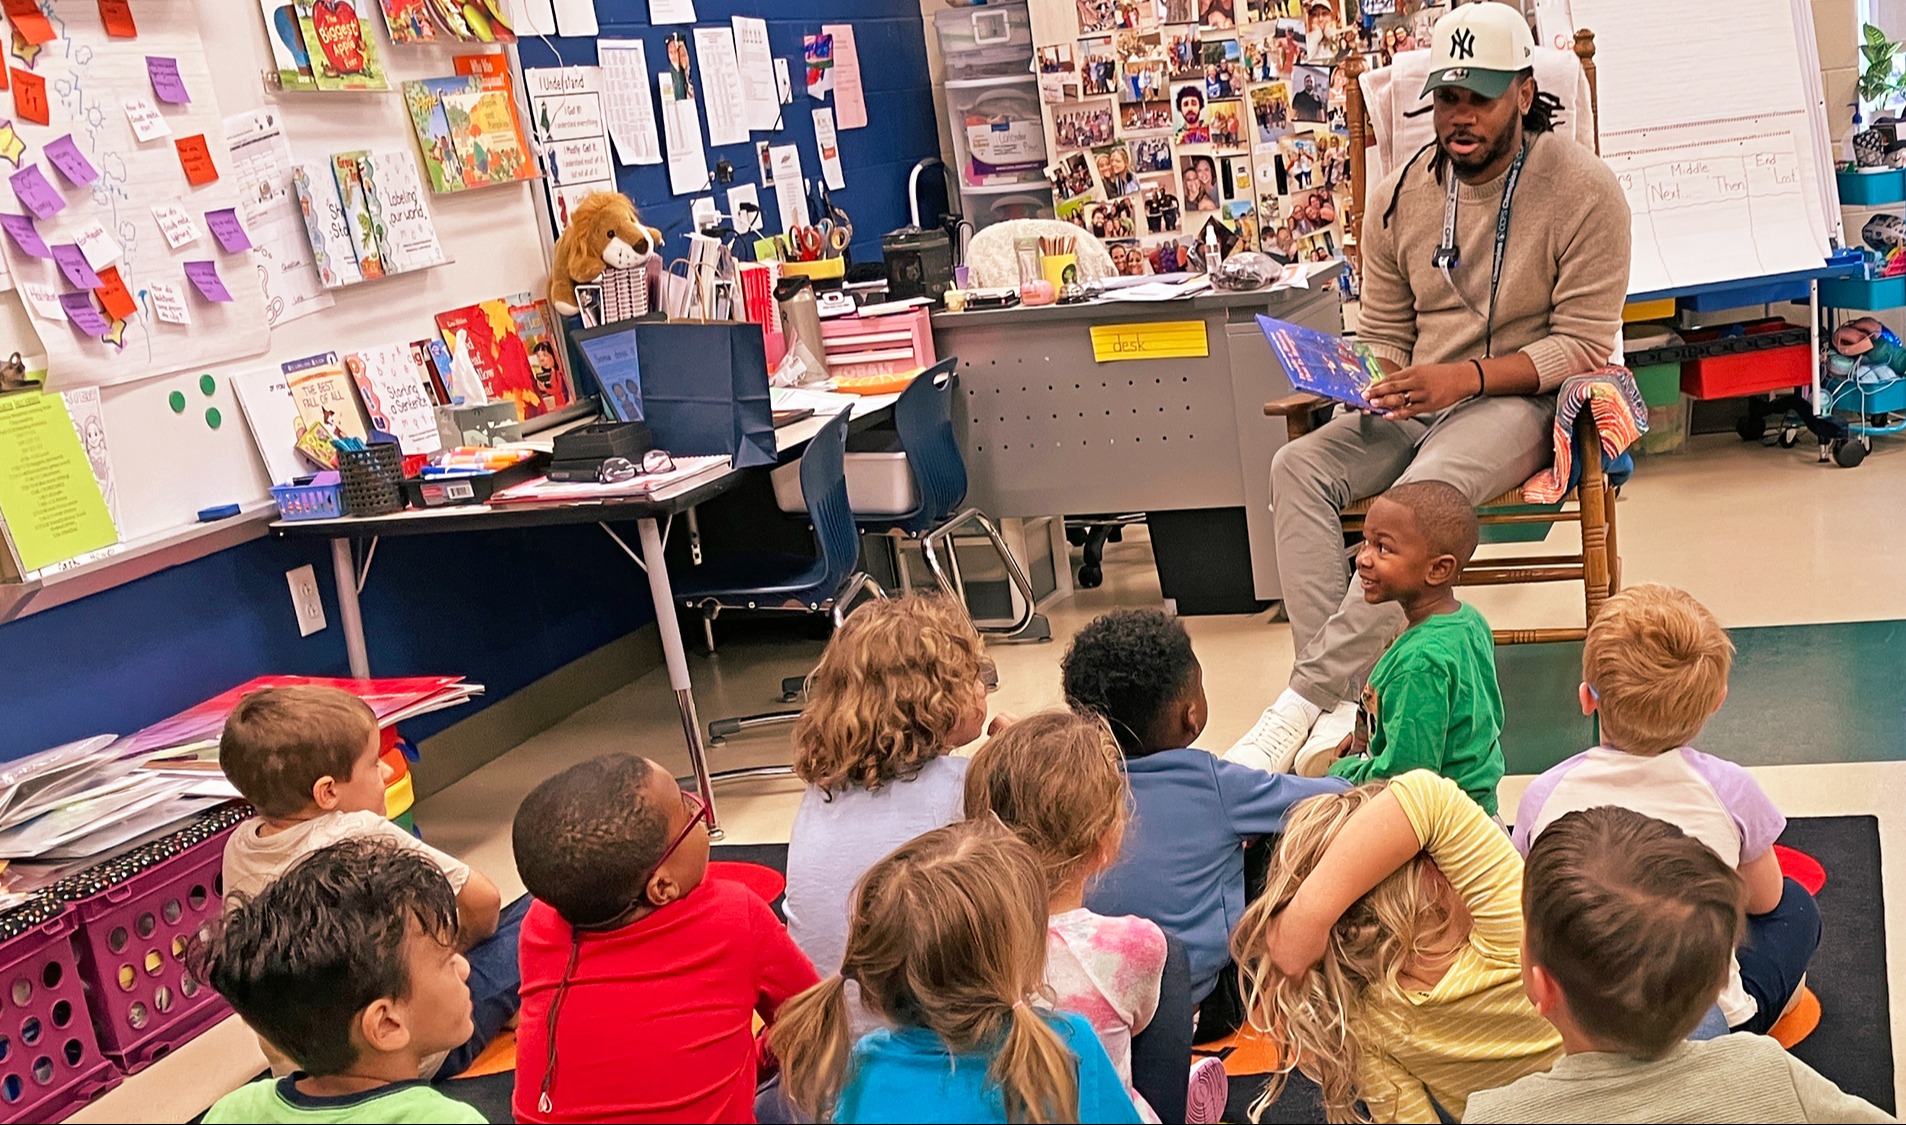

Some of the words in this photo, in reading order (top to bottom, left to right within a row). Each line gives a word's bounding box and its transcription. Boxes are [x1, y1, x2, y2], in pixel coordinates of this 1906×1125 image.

[325, 15, 337, 24] The
[319, 20, 358, 44] Biggest
[333, 39, 356, 58] Apple
[1450, 27, 1475, 60] NY
[1554, 34, 1575, 50] Ob
[344, 58, 358, 69] Ever
[1754, 153, 1776, 167] End
[1671, 162, 1710, 178] Middle
[384, 186, 418, 207] Labeling
[329, 203, 343, 220] Sh
[391, 212, 402, 223] our
[1113, 333, 1148, 352] desk
[476, 367, 494, 381] llow
[302, 385, 317, 396] THE
[318, 380, 335, 393] BEST
[387, 382, 421, 401] Starting
[302, 397, 320, 409] FALL
[320, 394, 329, 404] OF
[331, 390, 345, 401] ALL
[391, 405, 397, 414] a
[396, 397, 427, 413] Sentence
